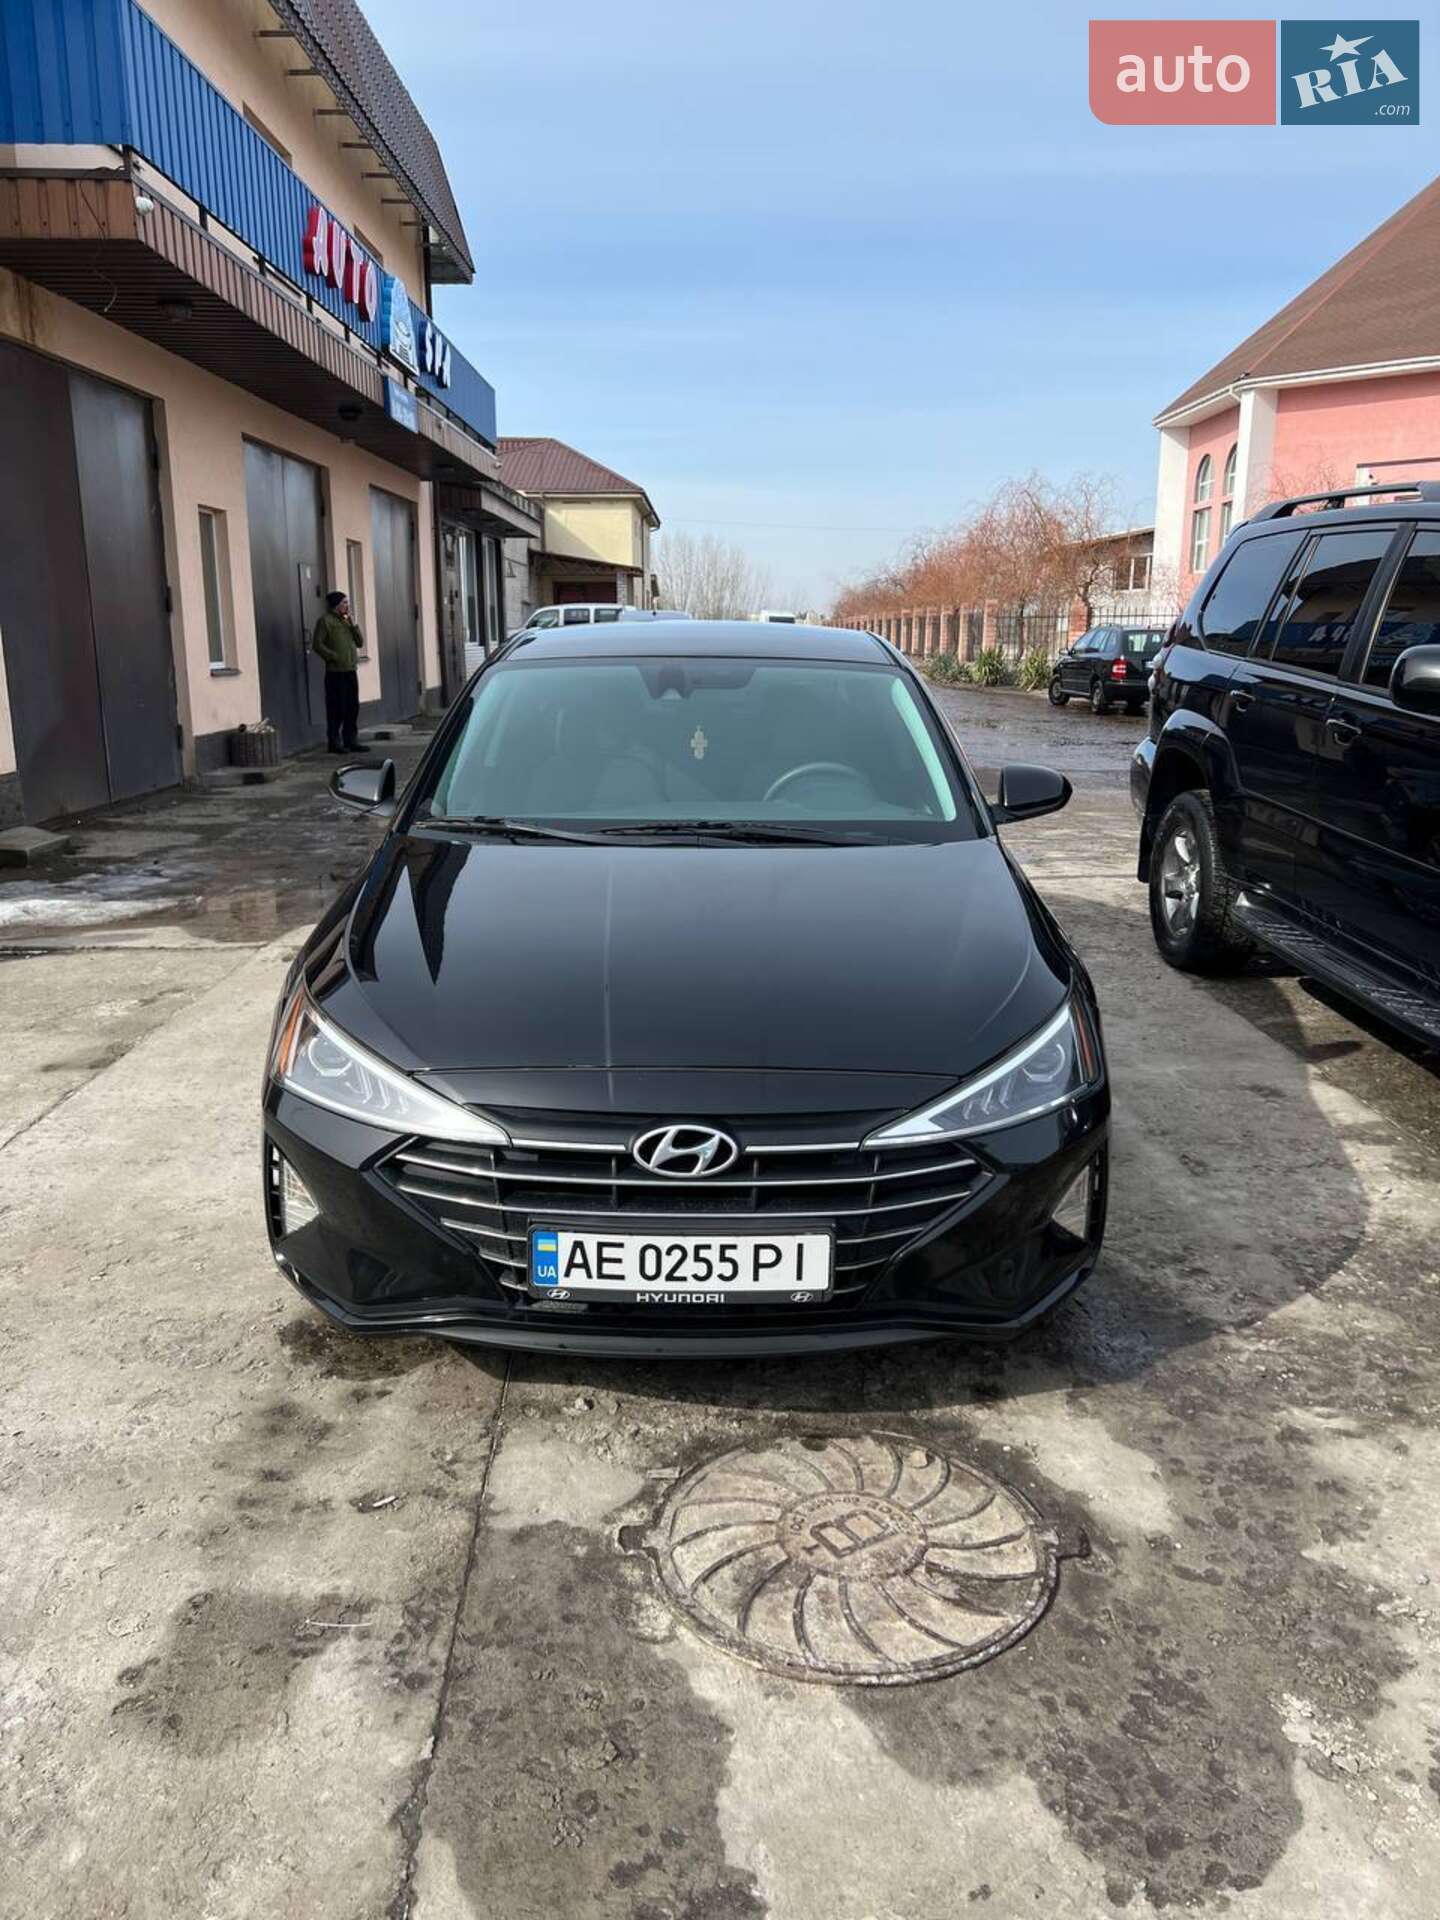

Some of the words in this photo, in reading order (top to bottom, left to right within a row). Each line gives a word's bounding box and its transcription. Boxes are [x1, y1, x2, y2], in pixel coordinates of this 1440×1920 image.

[309, 206, 377, 322] AUTO
[424, 321, 451, 388] SPA
[537, 1265, 557, 1278] UA
[564, 1240, 626, 1281] AE
[638, 1243, 739, 1282] 0255
[636, 1292, 725, 1304] HYUNDAI
